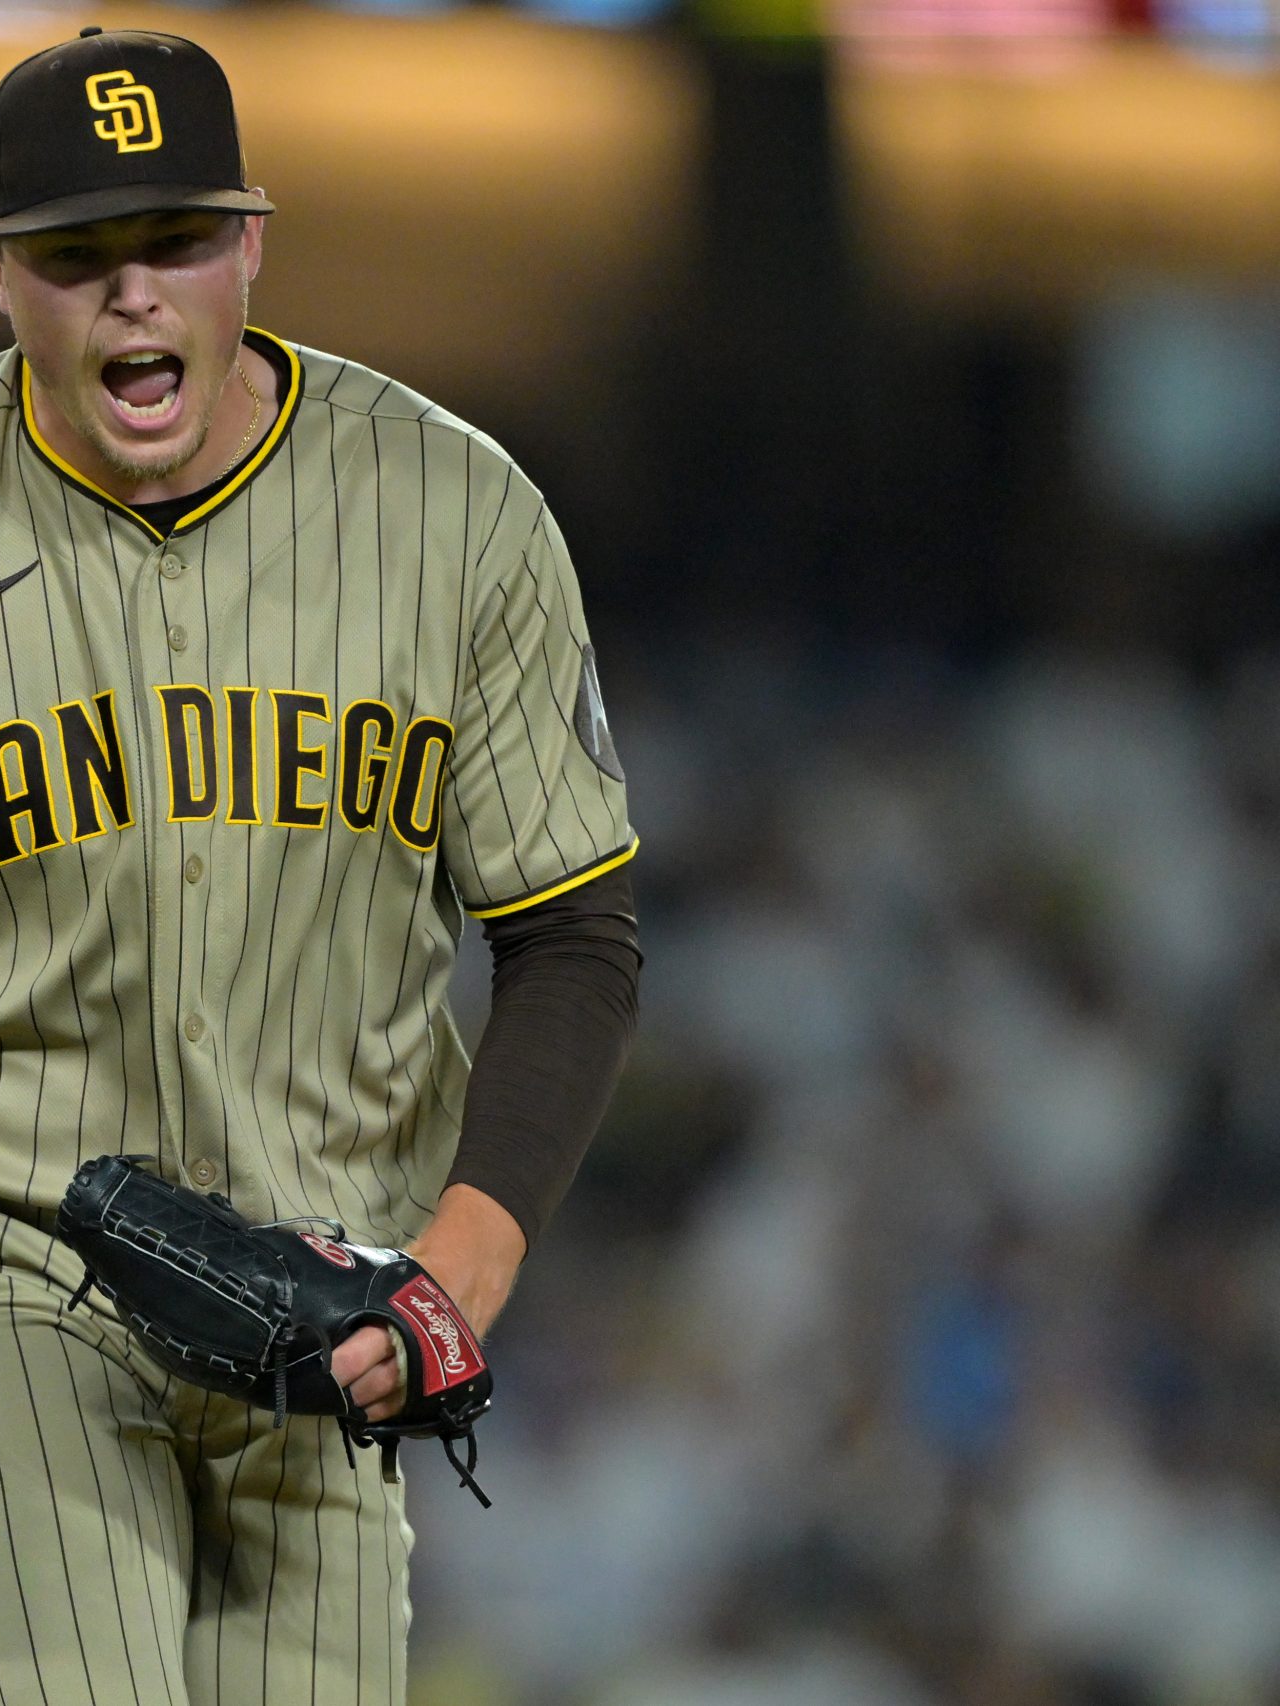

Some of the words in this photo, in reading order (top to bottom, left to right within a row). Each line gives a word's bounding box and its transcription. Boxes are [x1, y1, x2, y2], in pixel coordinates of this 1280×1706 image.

[85, 69, 163, 154] SD
[152, 683, 455, 853] DIEGO
[408, 1295, 466, 1374] Rawlings
